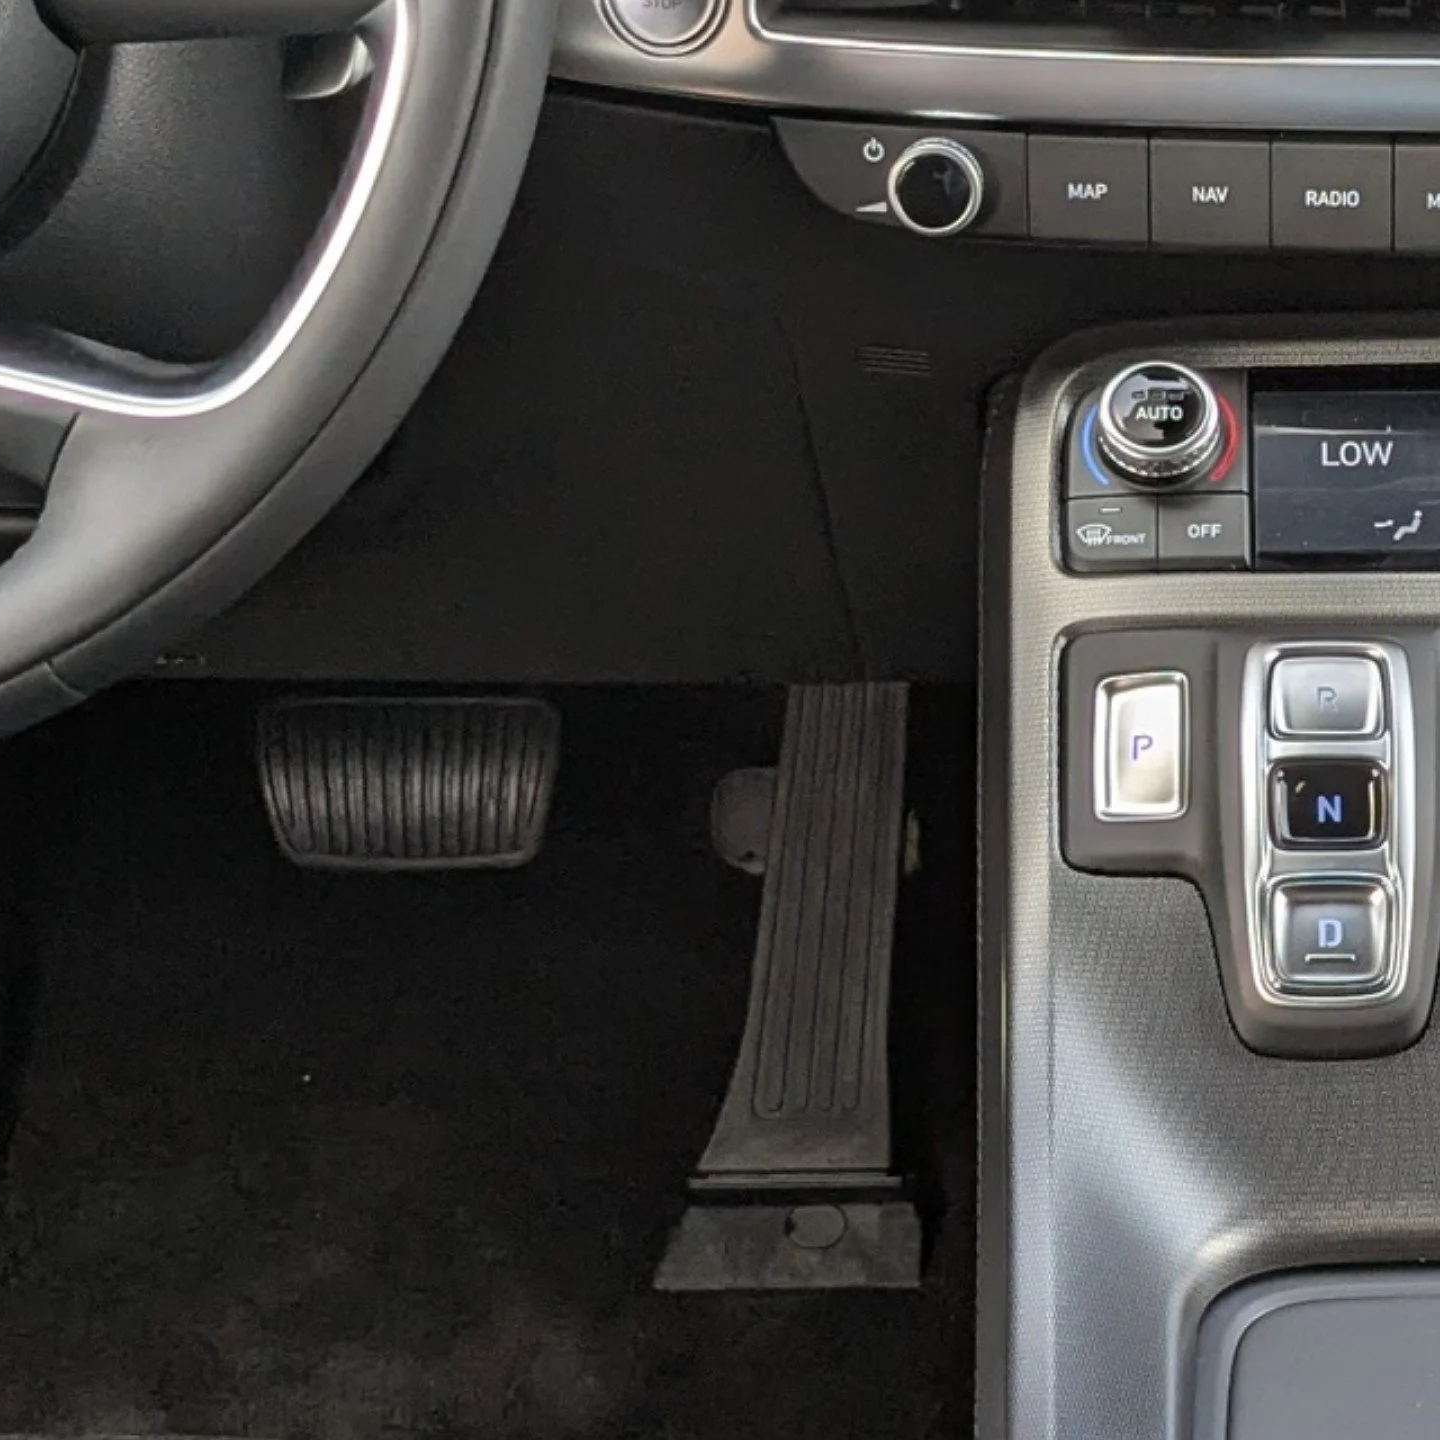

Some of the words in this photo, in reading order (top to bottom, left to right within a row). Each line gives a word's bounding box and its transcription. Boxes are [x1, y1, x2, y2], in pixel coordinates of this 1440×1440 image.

[1068, 183, 1108, 199] MAP
[1192, 186, 1227, 203] NAV
[1305, 190, 1359, 207] RADIO
[1135, 406, 1183, 421] AUTO
[1320, 441, 1394, 467] LOW
[1108, 533, 1147, 546] FRONT
[1187, 524, 1223, 539] OFF
[1317, 687, 1338, 711] R
[1132, 734, 1154, 760] P
[1317, 795, 1342, 823] N
[1318, 919, 1343, 947] D
